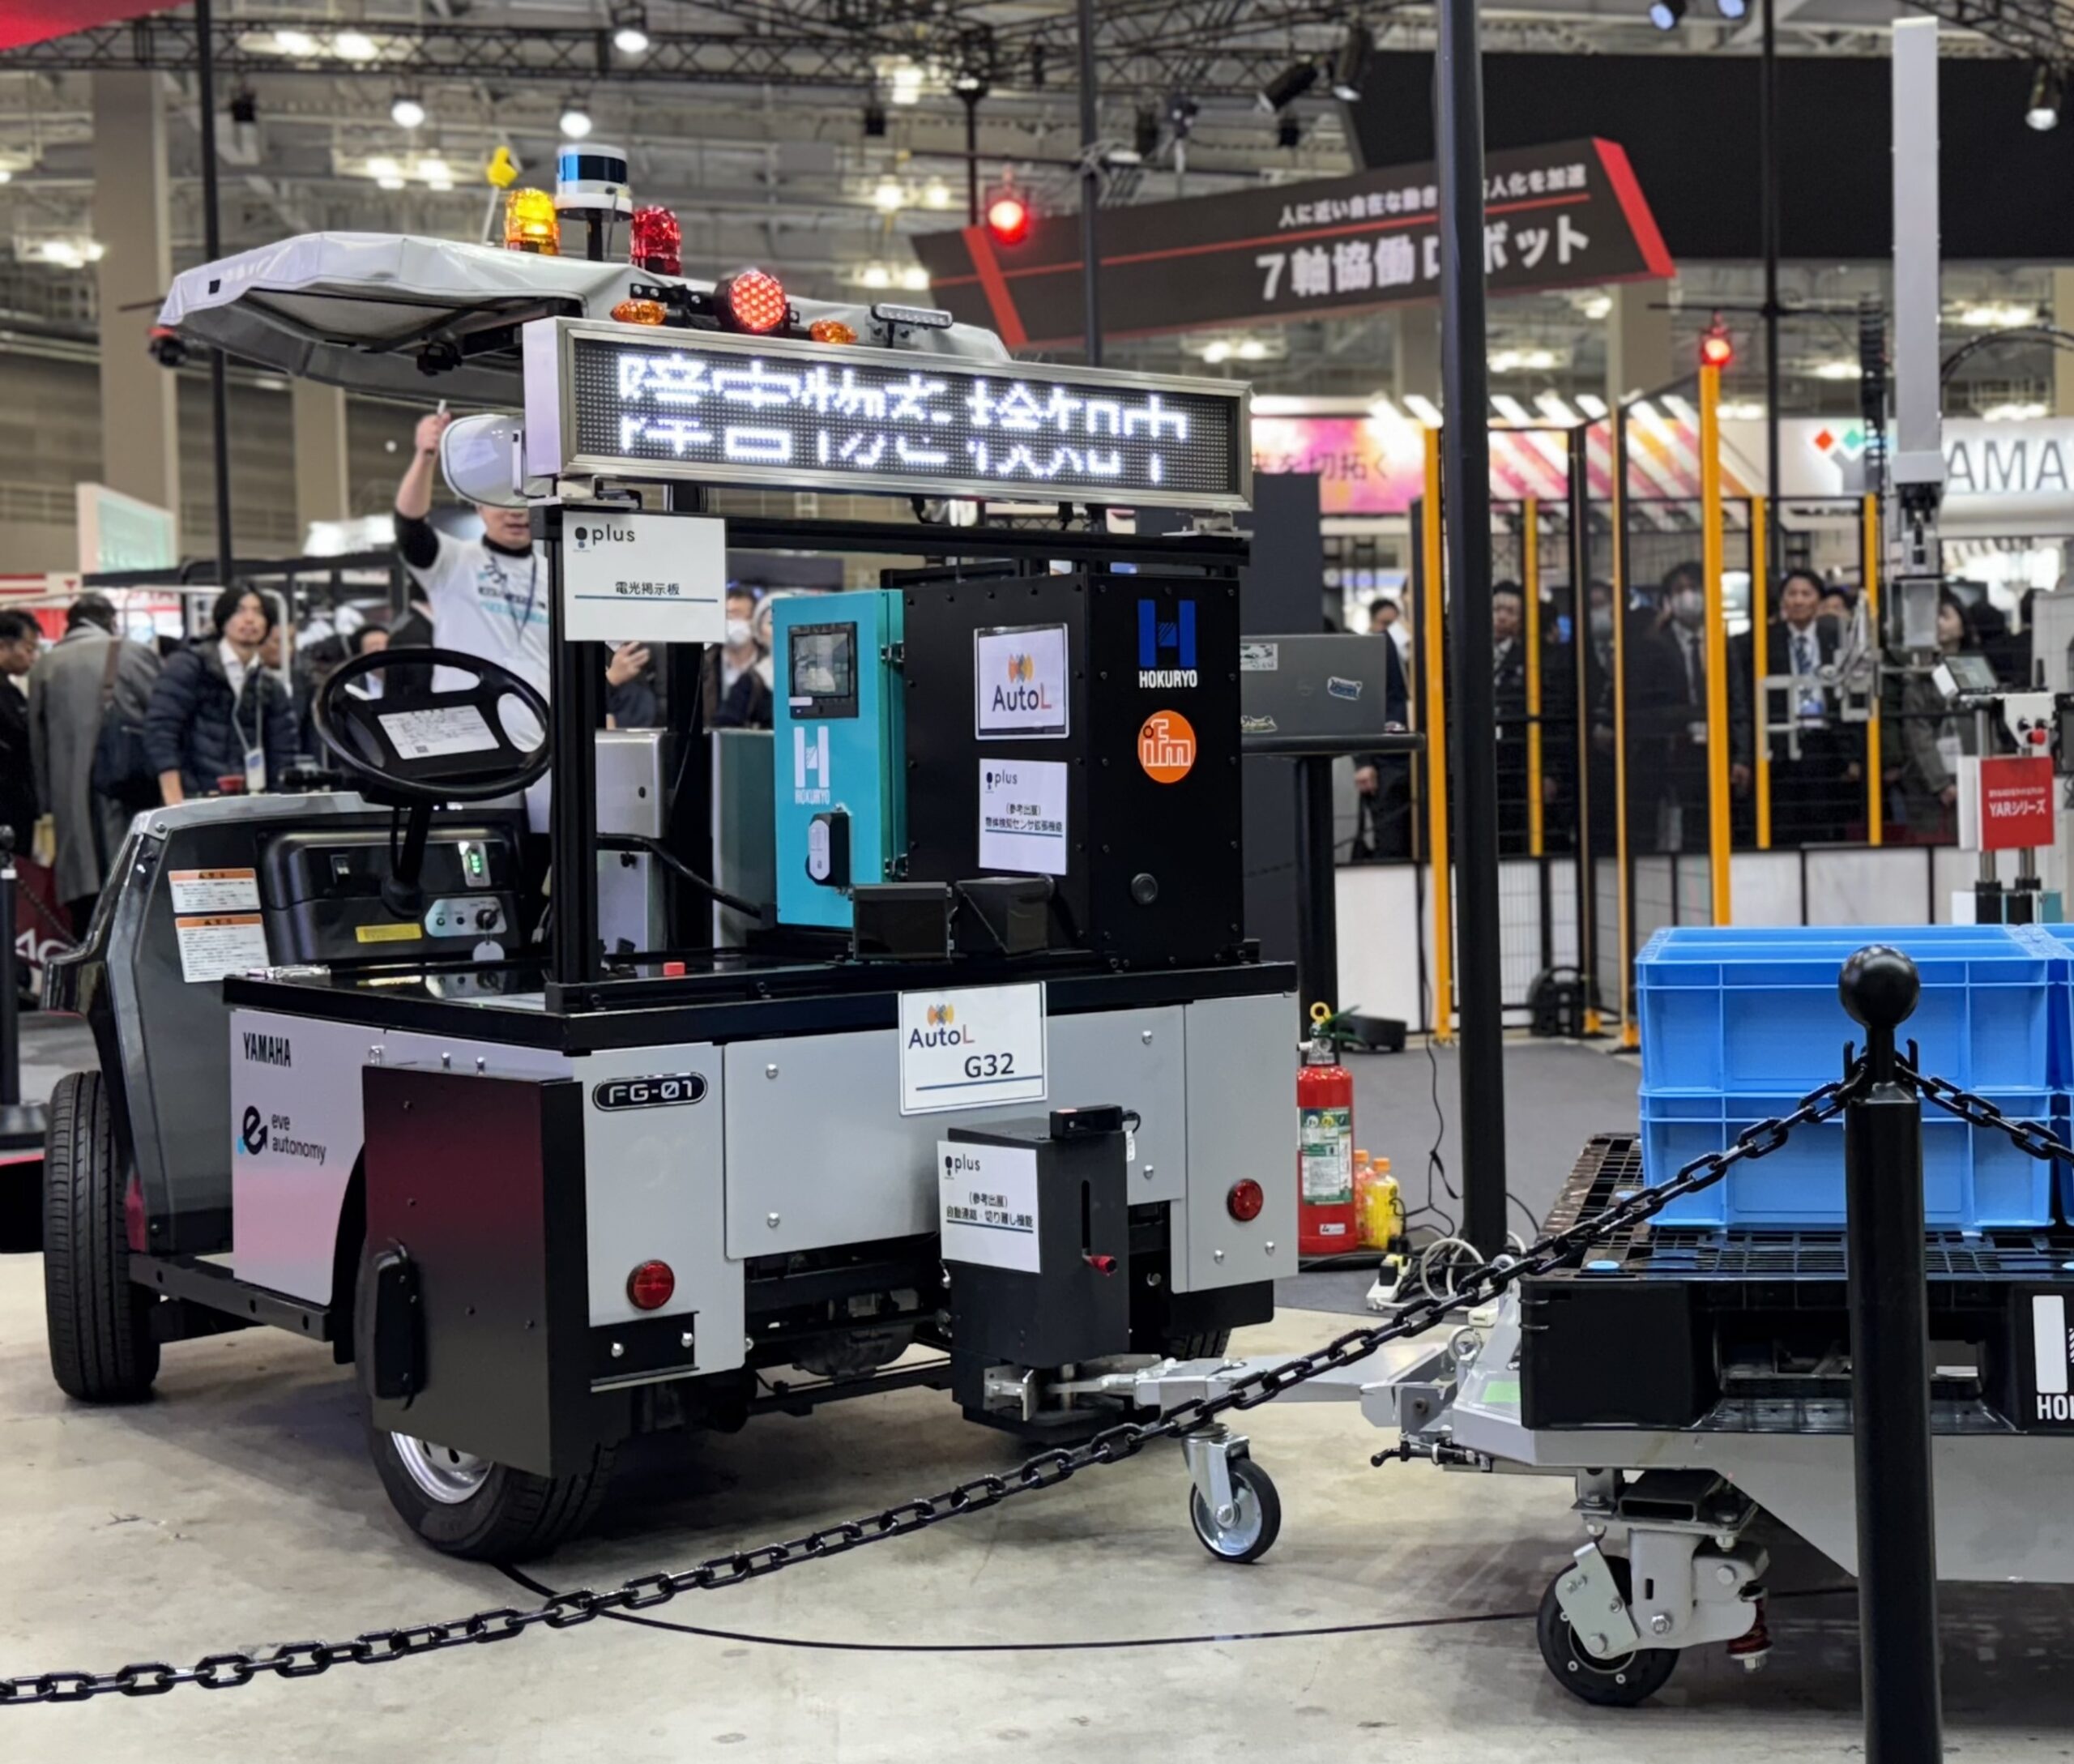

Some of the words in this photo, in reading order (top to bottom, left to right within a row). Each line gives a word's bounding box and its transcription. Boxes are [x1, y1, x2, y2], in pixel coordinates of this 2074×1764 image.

[1948, 440, 2069, 492] AMA
[592, 524, 635, 545] plus
[615, 581, 680, 596] 電光掲示板
[1139, 669, 1197, 688] HOKURYO
[992, 683, 1052, 711] AutoL
[1143, 718, 1191, 767] ifm
[995, 769, 1018, 787] plus
[1989, 798, 2046, 818] YARシリーズ
[908, 1024, 975, 1049] AutoL
[243, 1031, 292, 1068] YAMAHA
[964, 1053, 1014, 1078] G32
[609, 1079, 693, 1104] FG-01
[271, 1113, 291, 1131] eve
[272, 1136, 326, 1166] autonomy
[954, 1154, 980, 1173] plus
[2036, 1395, 2074, 1420] HO
